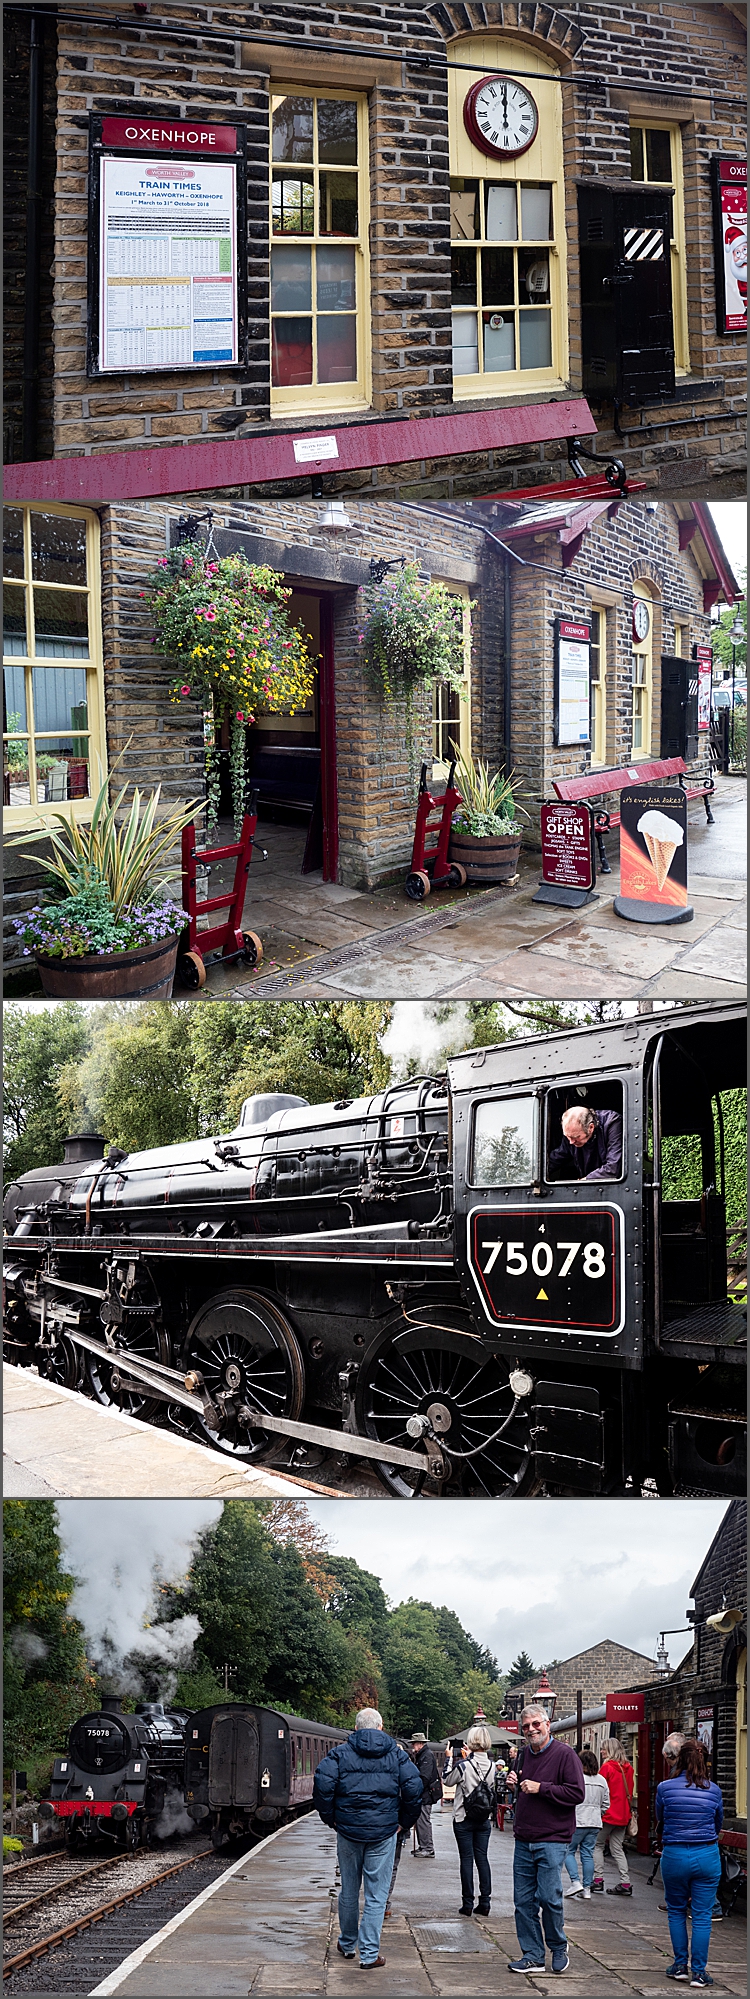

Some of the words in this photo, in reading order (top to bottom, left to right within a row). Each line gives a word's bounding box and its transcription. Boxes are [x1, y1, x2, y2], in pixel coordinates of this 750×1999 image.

[125, 127, 216, 145] OXENHOPE
[730, 166, 747, 176] OXE
[139, 181, 170, 189] TRAIN
[172, 182, 202, 190] TIMES
[565, 626, 585, 636] OXENHOPE
[633, 796, 660, 807] english
[547, 824, 583, 835] OPEN
[538, 1224, 546, 1233] 4
[481, 1241, 606, 1279] 75078
